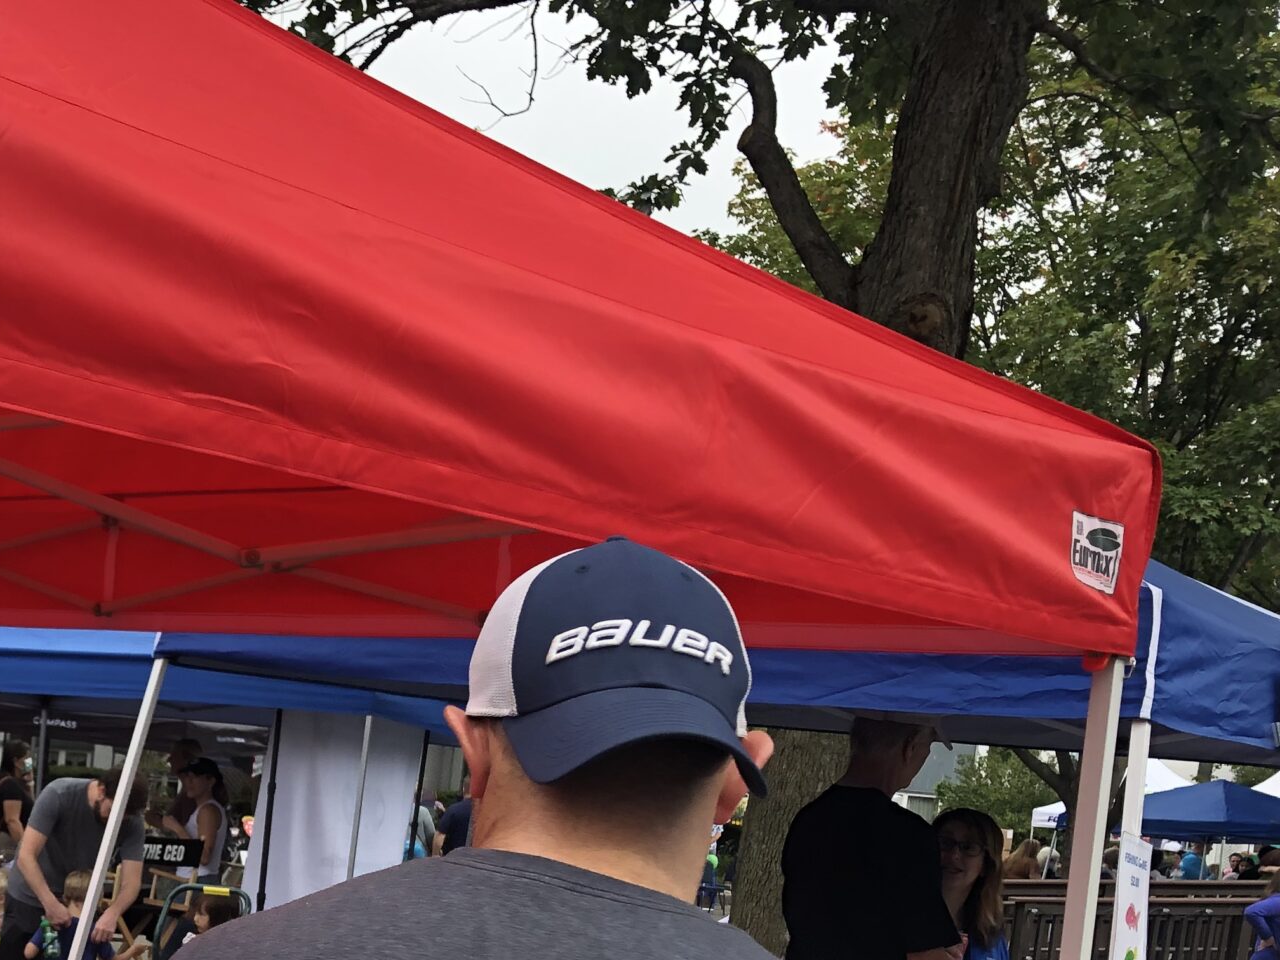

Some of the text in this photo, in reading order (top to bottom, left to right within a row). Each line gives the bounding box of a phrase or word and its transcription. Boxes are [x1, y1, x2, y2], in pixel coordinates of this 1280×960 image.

[32, 716, 77, 729] CMPASS
[143, 843, 186, 862] THE CEO
